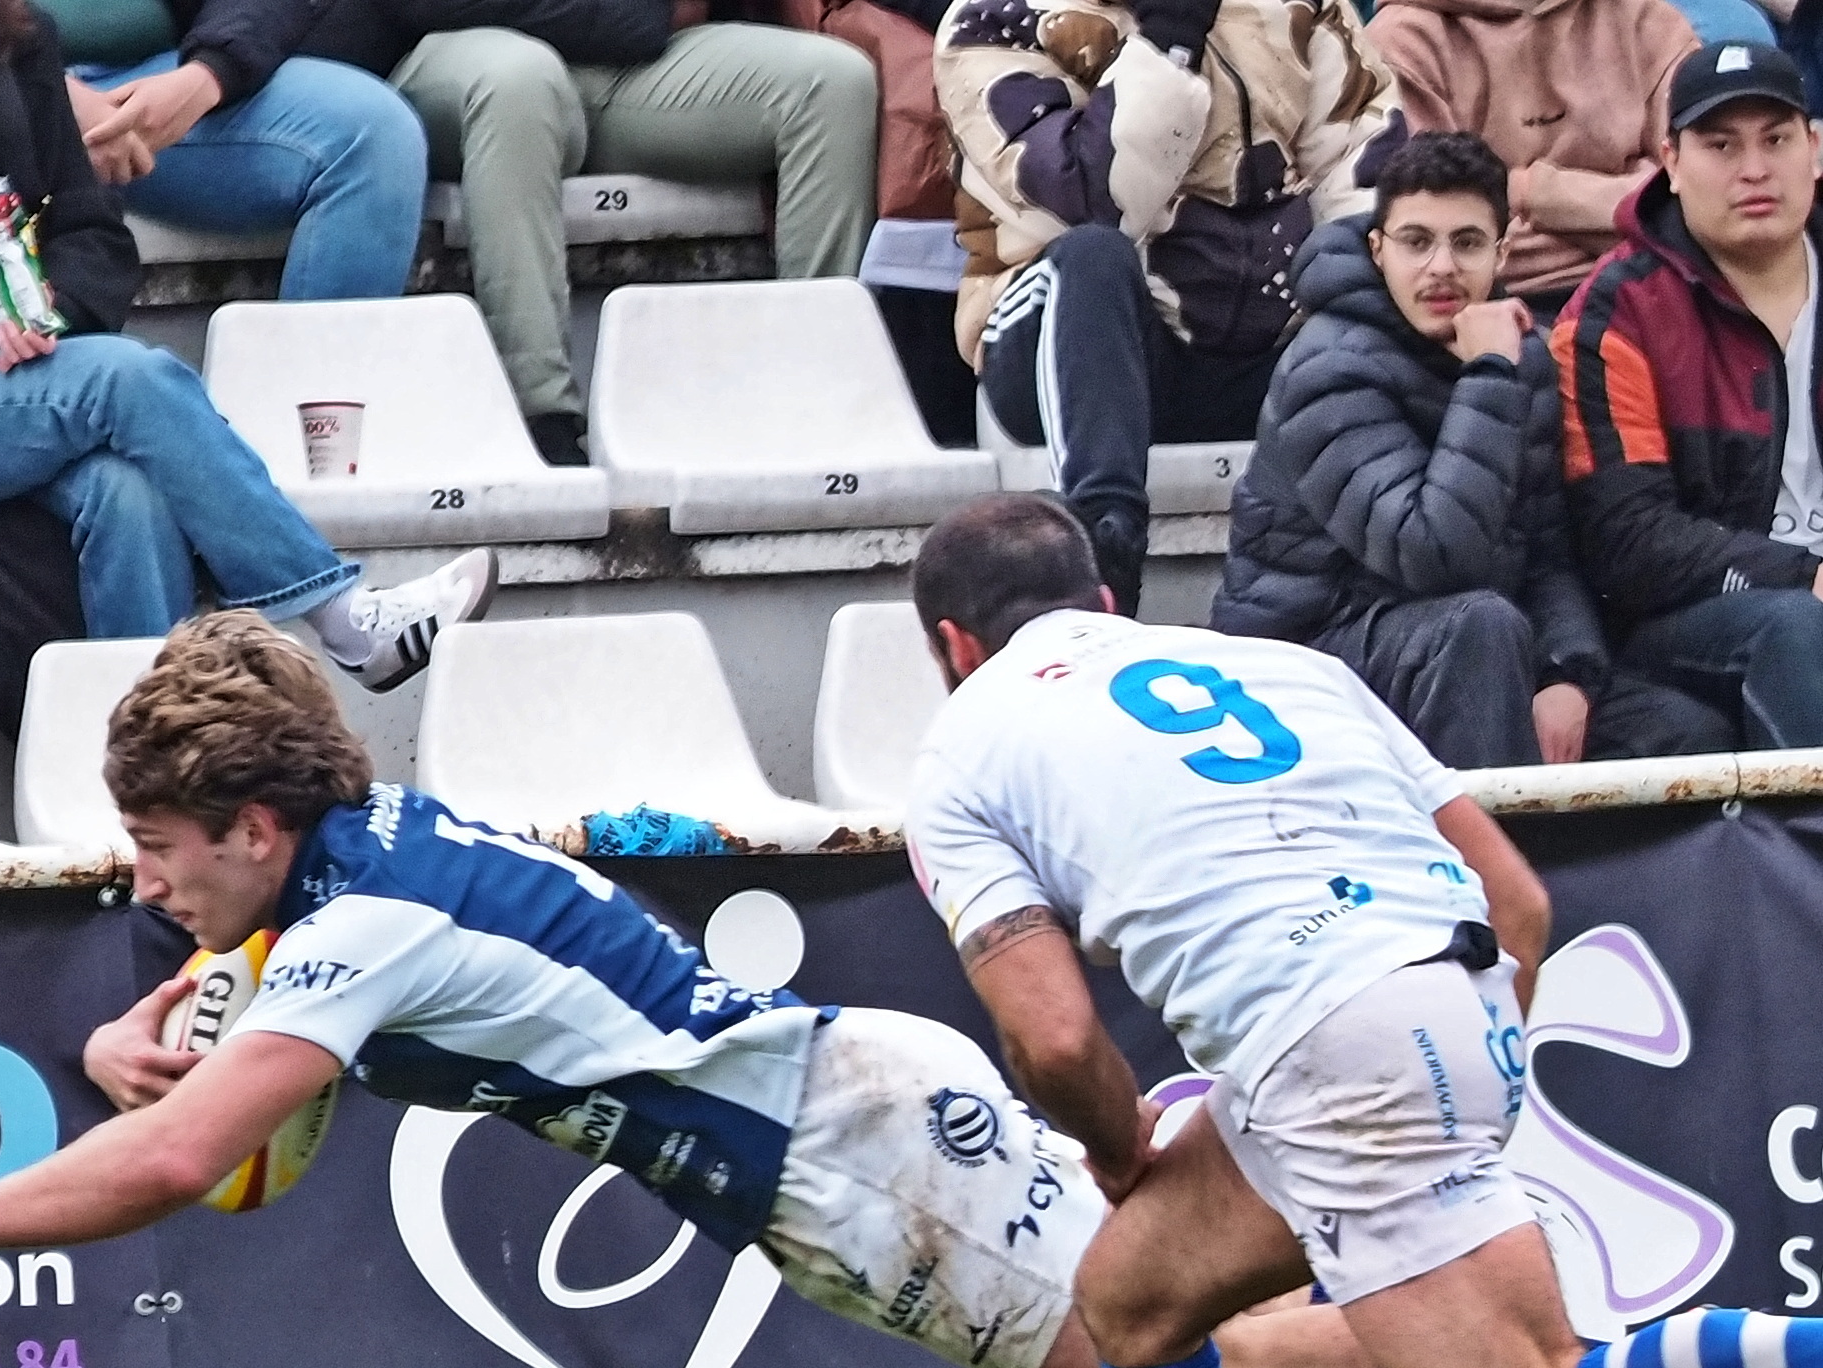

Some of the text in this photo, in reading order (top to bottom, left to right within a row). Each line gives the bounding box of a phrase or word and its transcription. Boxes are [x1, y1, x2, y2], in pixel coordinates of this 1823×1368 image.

[595, 190, 628, 210] 29
[825, 473, 859, 495] 29
[430, 488, 465, 509] 28
[1109, 658, 1301, 784] 9
